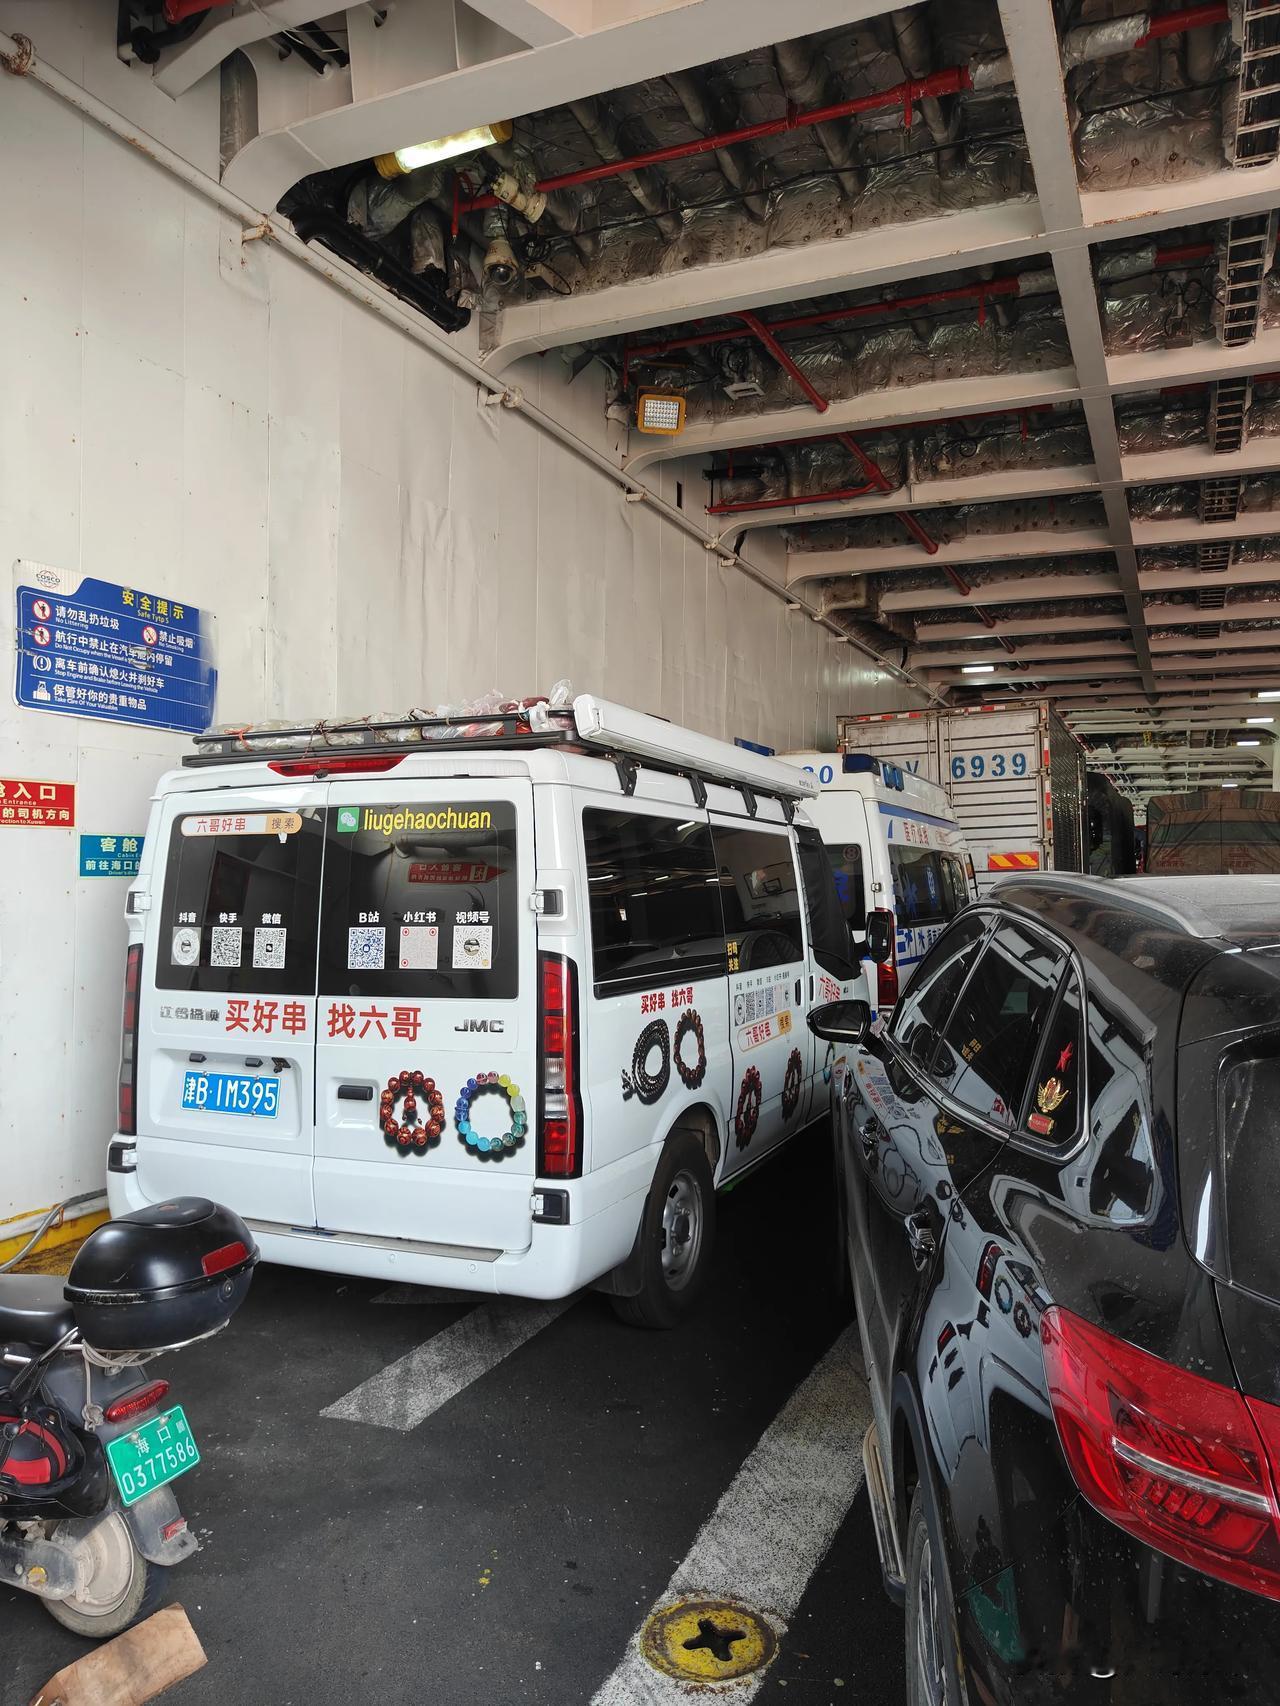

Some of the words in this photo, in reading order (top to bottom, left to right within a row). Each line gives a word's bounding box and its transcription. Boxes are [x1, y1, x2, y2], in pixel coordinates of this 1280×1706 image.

[36, 573, 61, 583] COSCO
[122, 590, 184, 619] 安全提示
[55, 604, 120, 630] 请勿乱扔垃圾
[56, 616, 64, 624] No
[64, 618, 89, 630] Littering
[159, 630, 193, 649] 禁止吸烟
[53, 683, 147, 711] 保管好你的贵重物品
[951, 753, 1027, 779] 6939
[2, 807, 70, 820] 的司机方向
[364, 807, 491, 836] liugehaochuan
[197, 818, 246, 832] 六哥好串
[272, 817, 294, 830] 搜索
[178, 912, 197, 923] 抖音
[219, 912, 238, 924] 快手
[262, 912, 282, 925] 微信
[358, 911, 380, 923] B站
[402, 911, 437, 923] 小红书
[455, 911, 491, 924] 视频号
[641, 992, 666, 1015] 买好串
[671, 986, 693, 1008] 找六哥
[225, 999, 307, 1035] 买好串
[327, 1003, 422, 1042] 找六哥
[455, 1018, 504, 1033] JMC
[184, 1077, 277, 1111] 津B·1M395
[135, 1426, 171, 1457] 海口
[122, 1437, 195, 1495] 0377586
